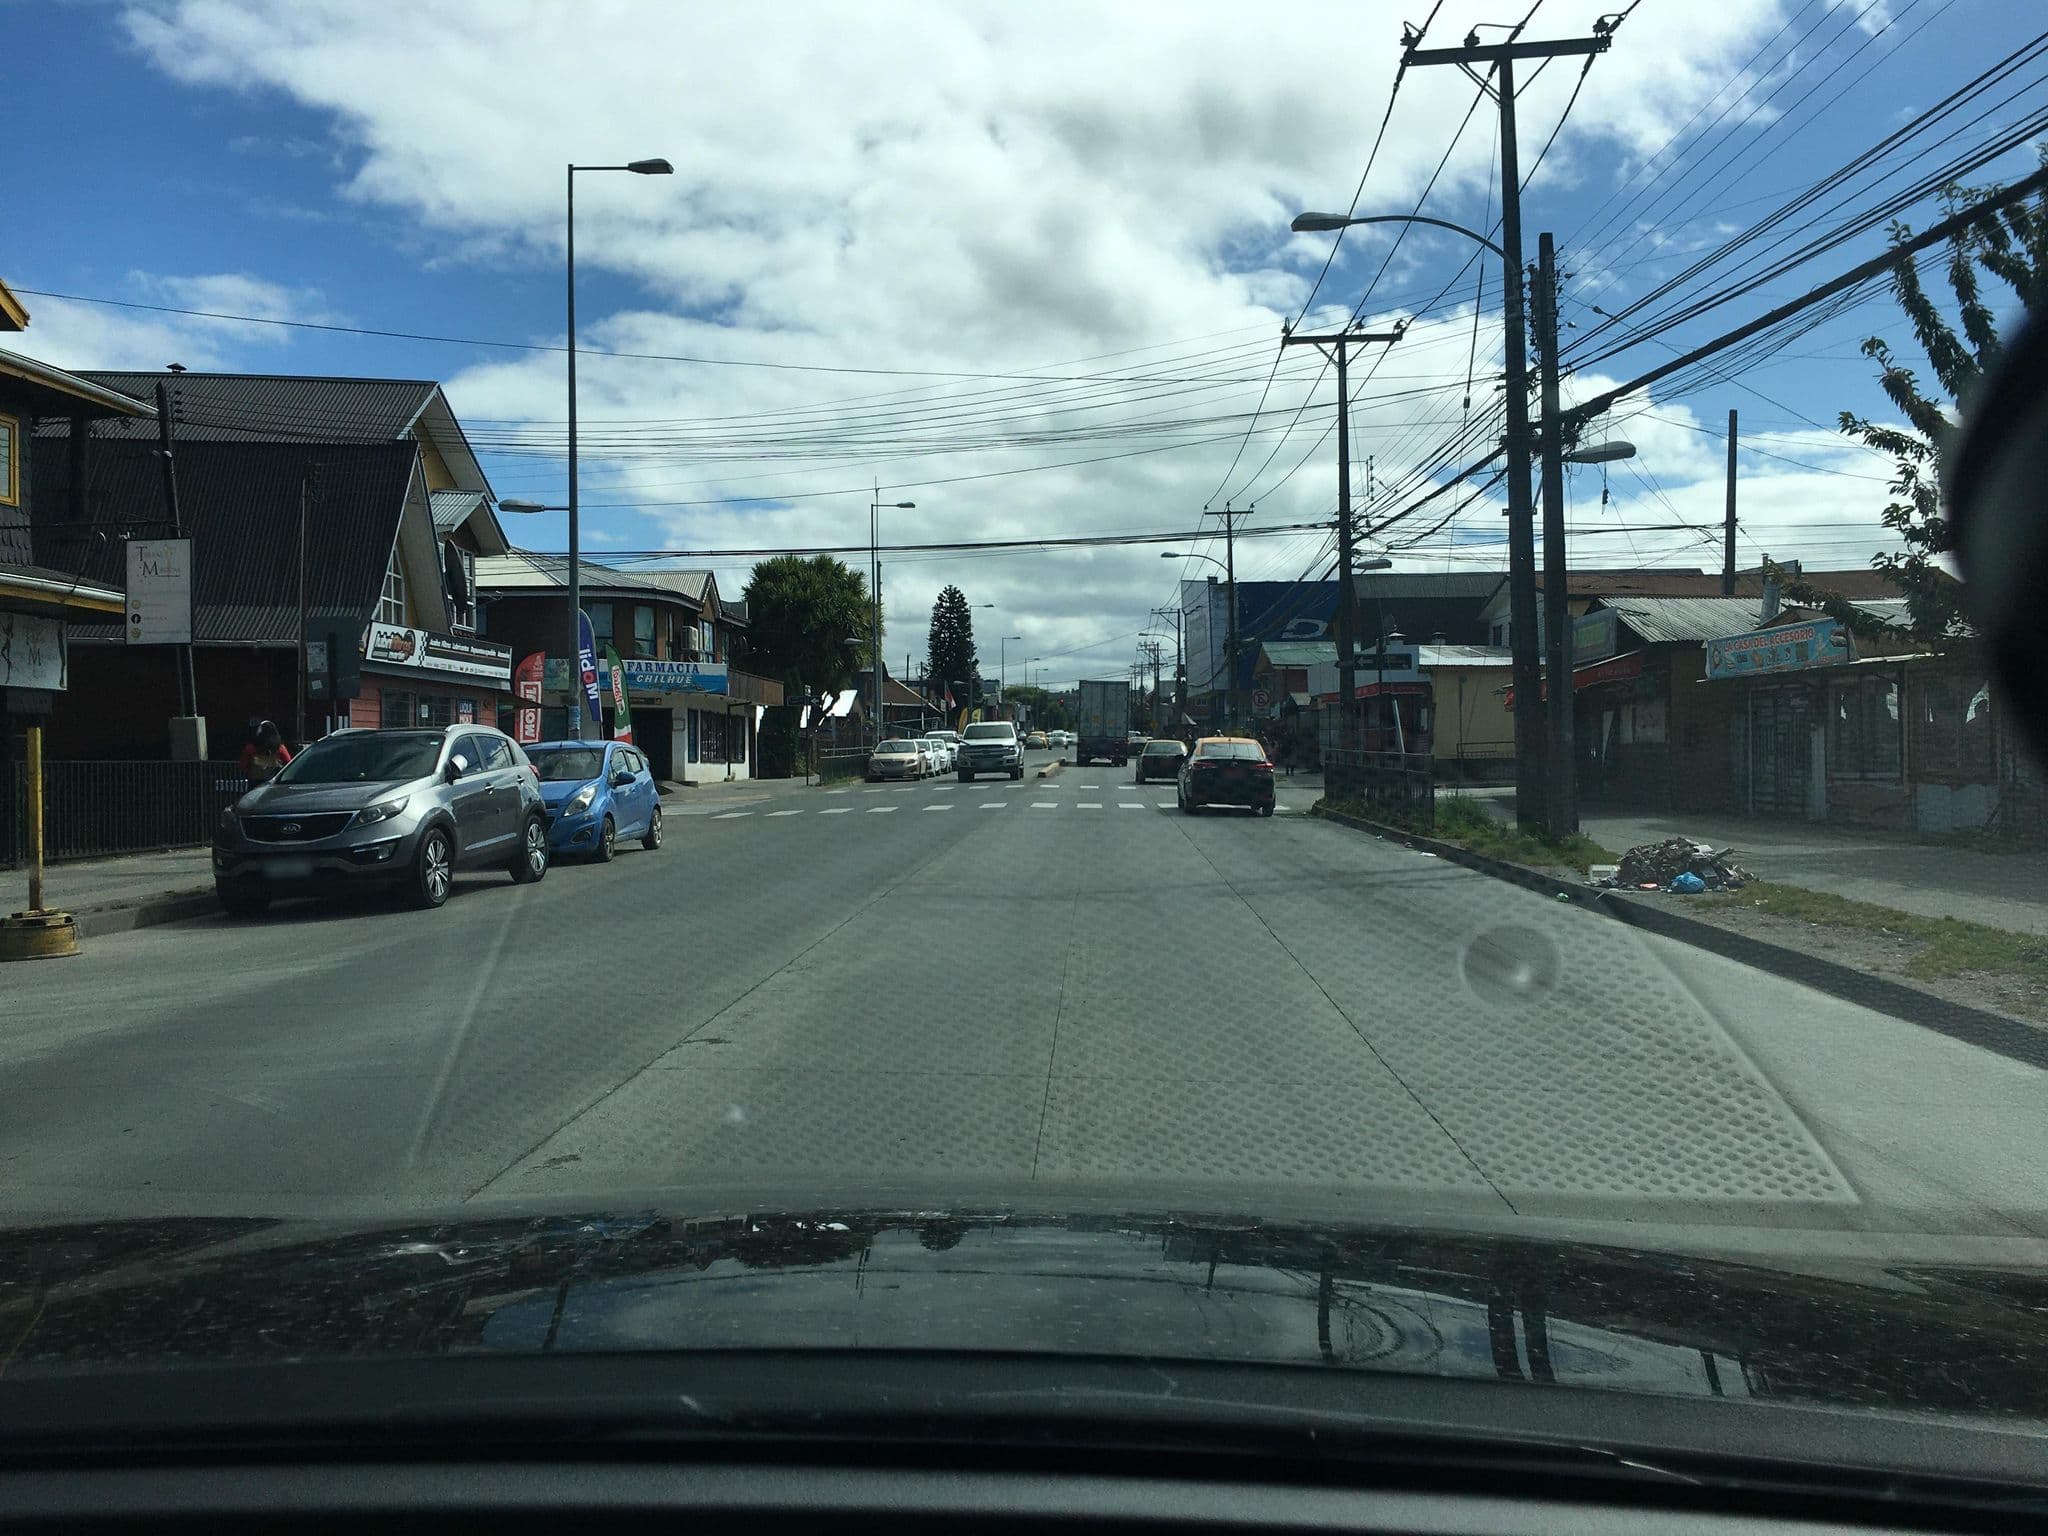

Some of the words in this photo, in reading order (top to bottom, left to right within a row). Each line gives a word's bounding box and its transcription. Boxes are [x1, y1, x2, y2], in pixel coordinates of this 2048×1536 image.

[1723, 640, 1735, 652] LA
[1735, 636, 1754, 650] CASA
[1754, 635, 1768, 648] DEL
[1769, 627, 1815, 647] ACCESORIO
[626, 661, 701, 675] FARMACIA
[636, 674, 693, 685] CHILHUE
